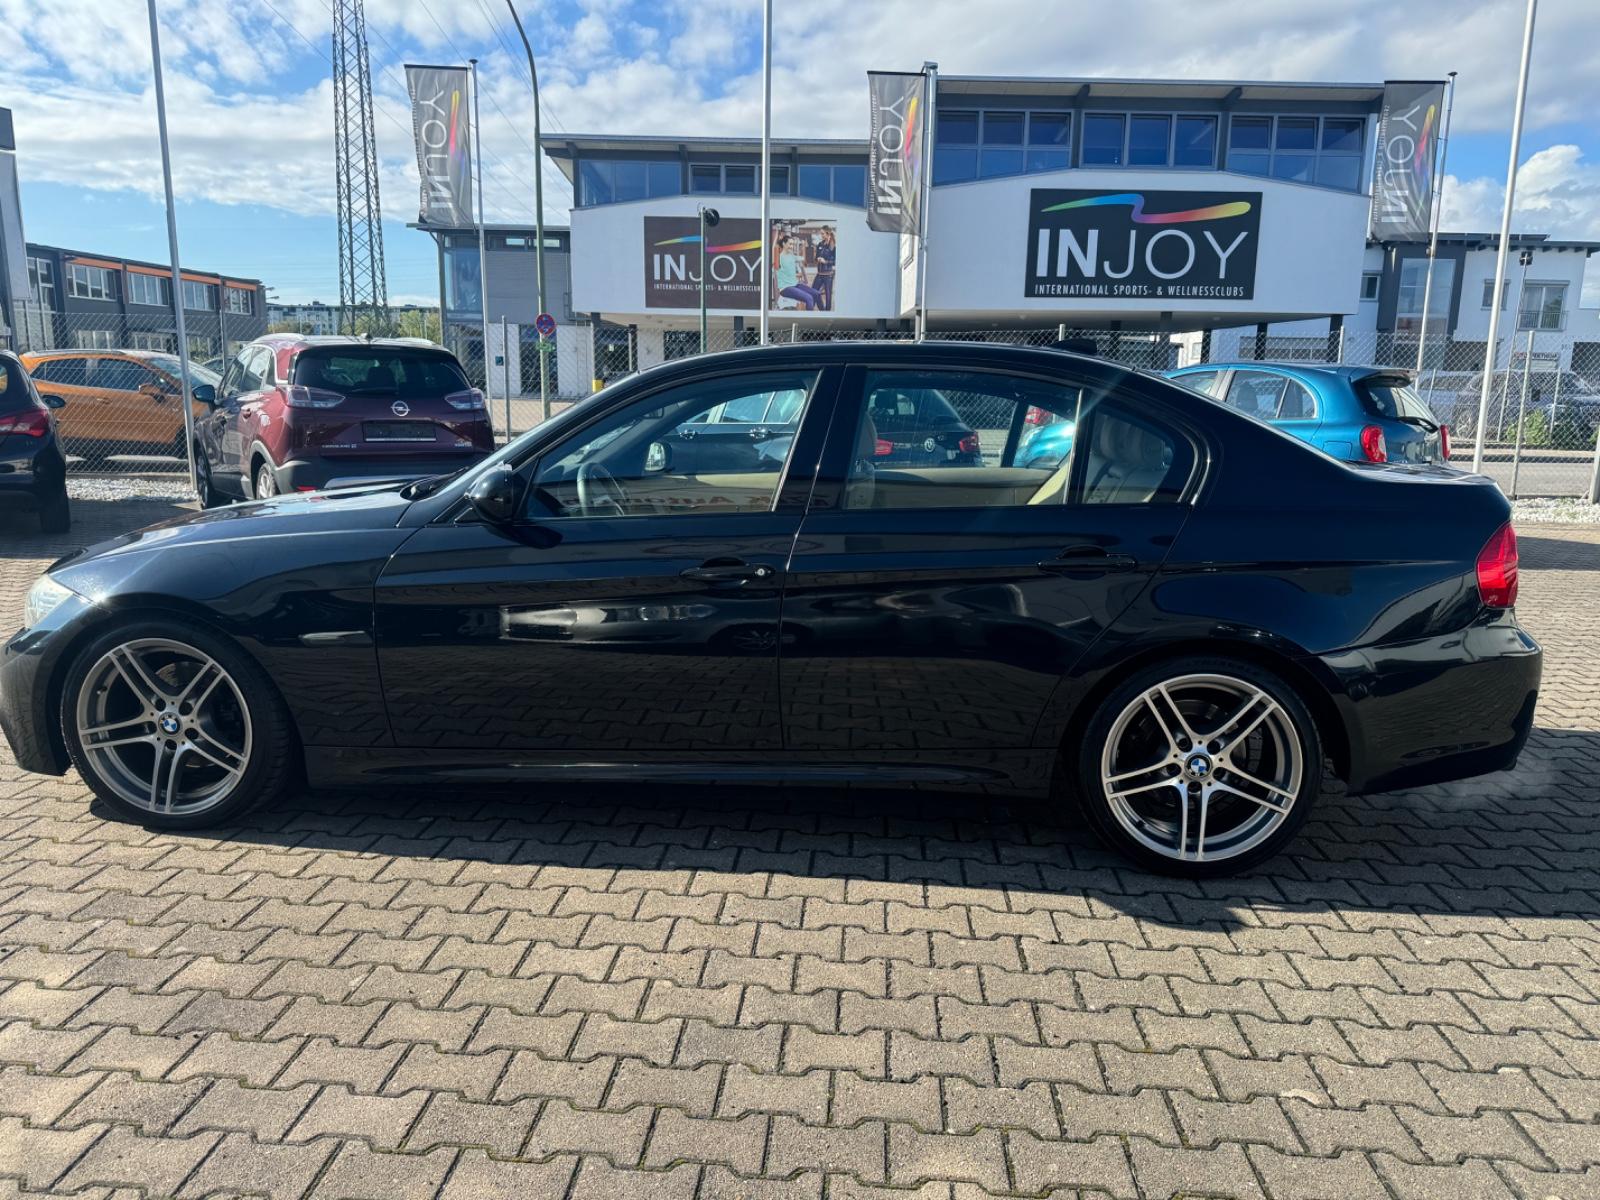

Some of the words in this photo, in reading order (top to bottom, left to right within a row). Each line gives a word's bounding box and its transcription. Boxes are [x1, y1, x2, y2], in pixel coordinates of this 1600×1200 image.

[1036, 228, 1249, 280] INJOY
[653, 283, 694, 291] INTERNATIONAL
[1034, 284, 1109, 295] INTERNATIONAL
[1113, 284, 1152, 296] SPORTS-
[1156, 286, 1163, 296] &
[1167, 285, 1244, 297] WELLNESSCLUBS
